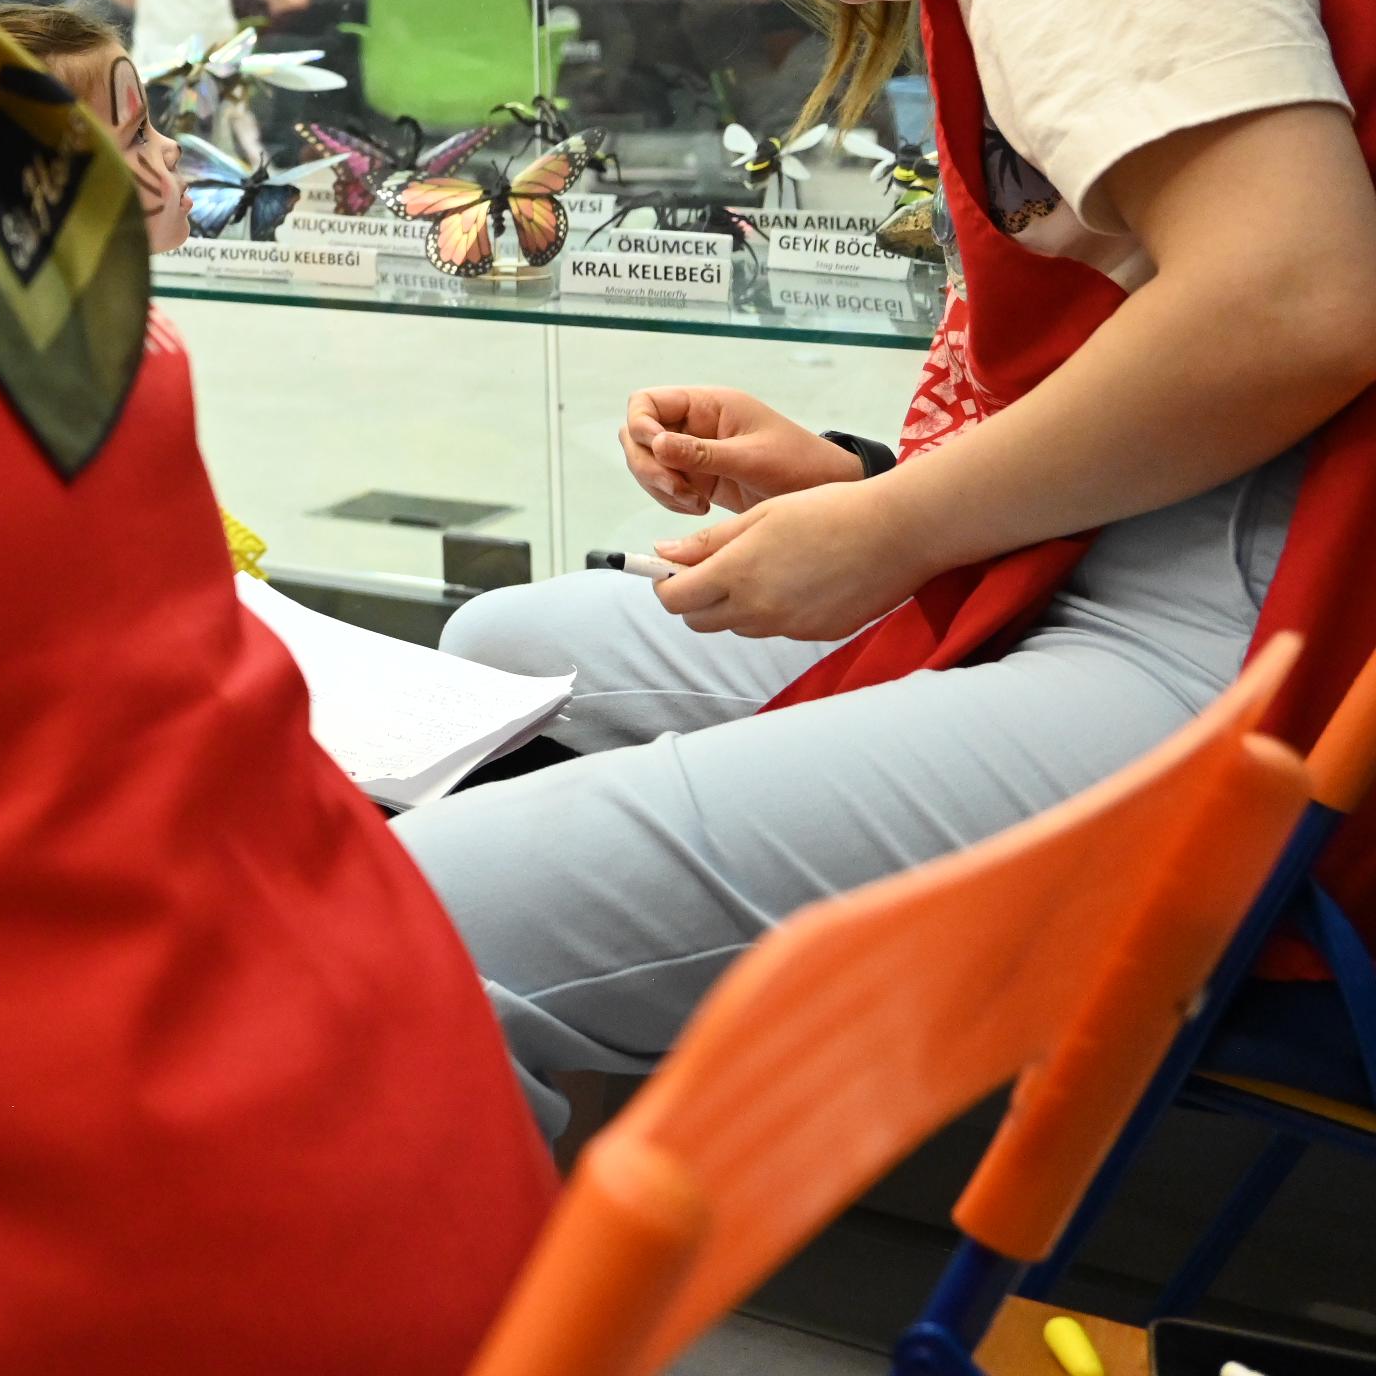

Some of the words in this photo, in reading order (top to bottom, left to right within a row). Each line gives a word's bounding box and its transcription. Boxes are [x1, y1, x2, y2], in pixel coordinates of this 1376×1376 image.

[561, 198, 603, 214] VESİ
[292, 217, 388, 237] KILIÇKUYRUK
[393, 224, 427, 239] KELE
[745, 214, 798, 229] ABAN
[618, 234, 717, 256] ÖRÜMCEK
[779, 234, 829, 254] GEYİK
[220, 245, 290, 263] KUYRUĞU
[294, 249, 361, 266] KELEBEĞİ
[572, 261, 621, 279] KRAL
[629, 263, 721, 284] KELEBEĞİ
